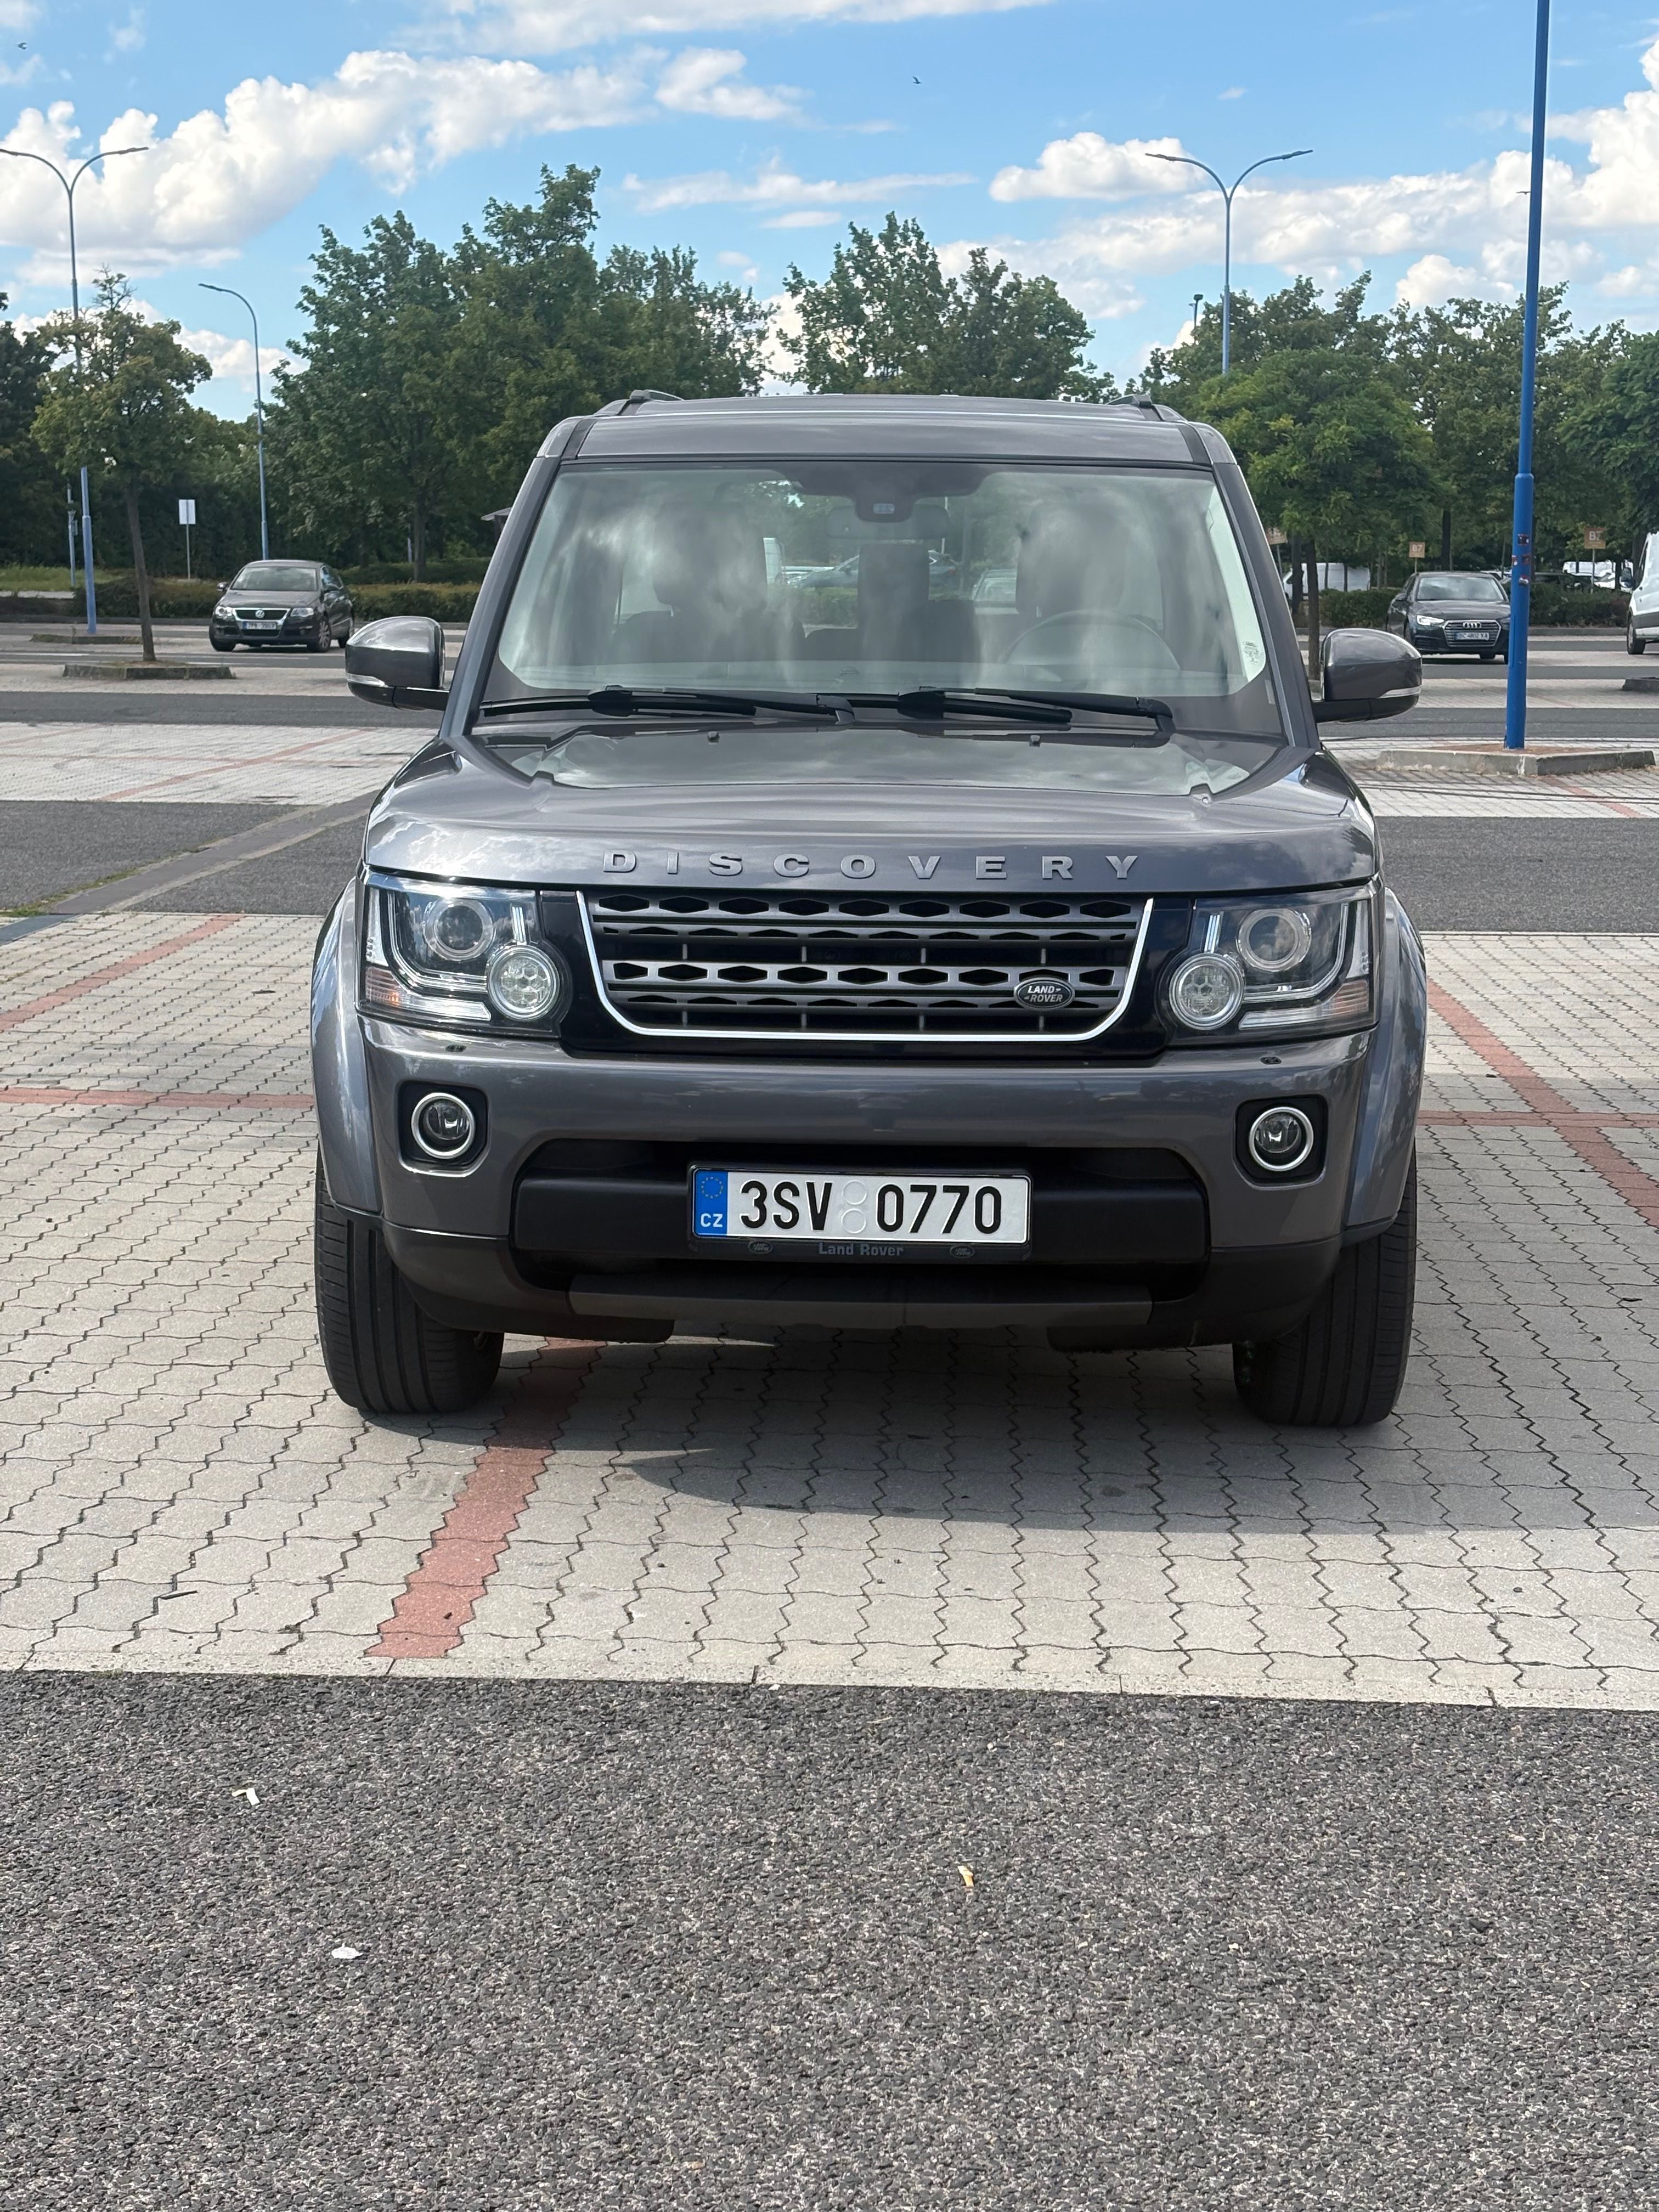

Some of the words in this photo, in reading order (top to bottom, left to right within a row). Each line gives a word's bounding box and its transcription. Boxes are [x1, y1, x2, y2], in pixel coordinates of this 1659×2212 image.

[603, 850, 1138, 880] DISCOVERY
[1027, 985, 1055, 994] LAND
[1029, 994, 1063, 1002] ROVER
[740, 1180, 833, 1231] 3SV
[876, 1184, 1002, 1234] 0770
[700, 1212, 723, 1228] CZ
[819, 1242, 854, 1255] Land
[860, 1243, 904, 1256] Rover
